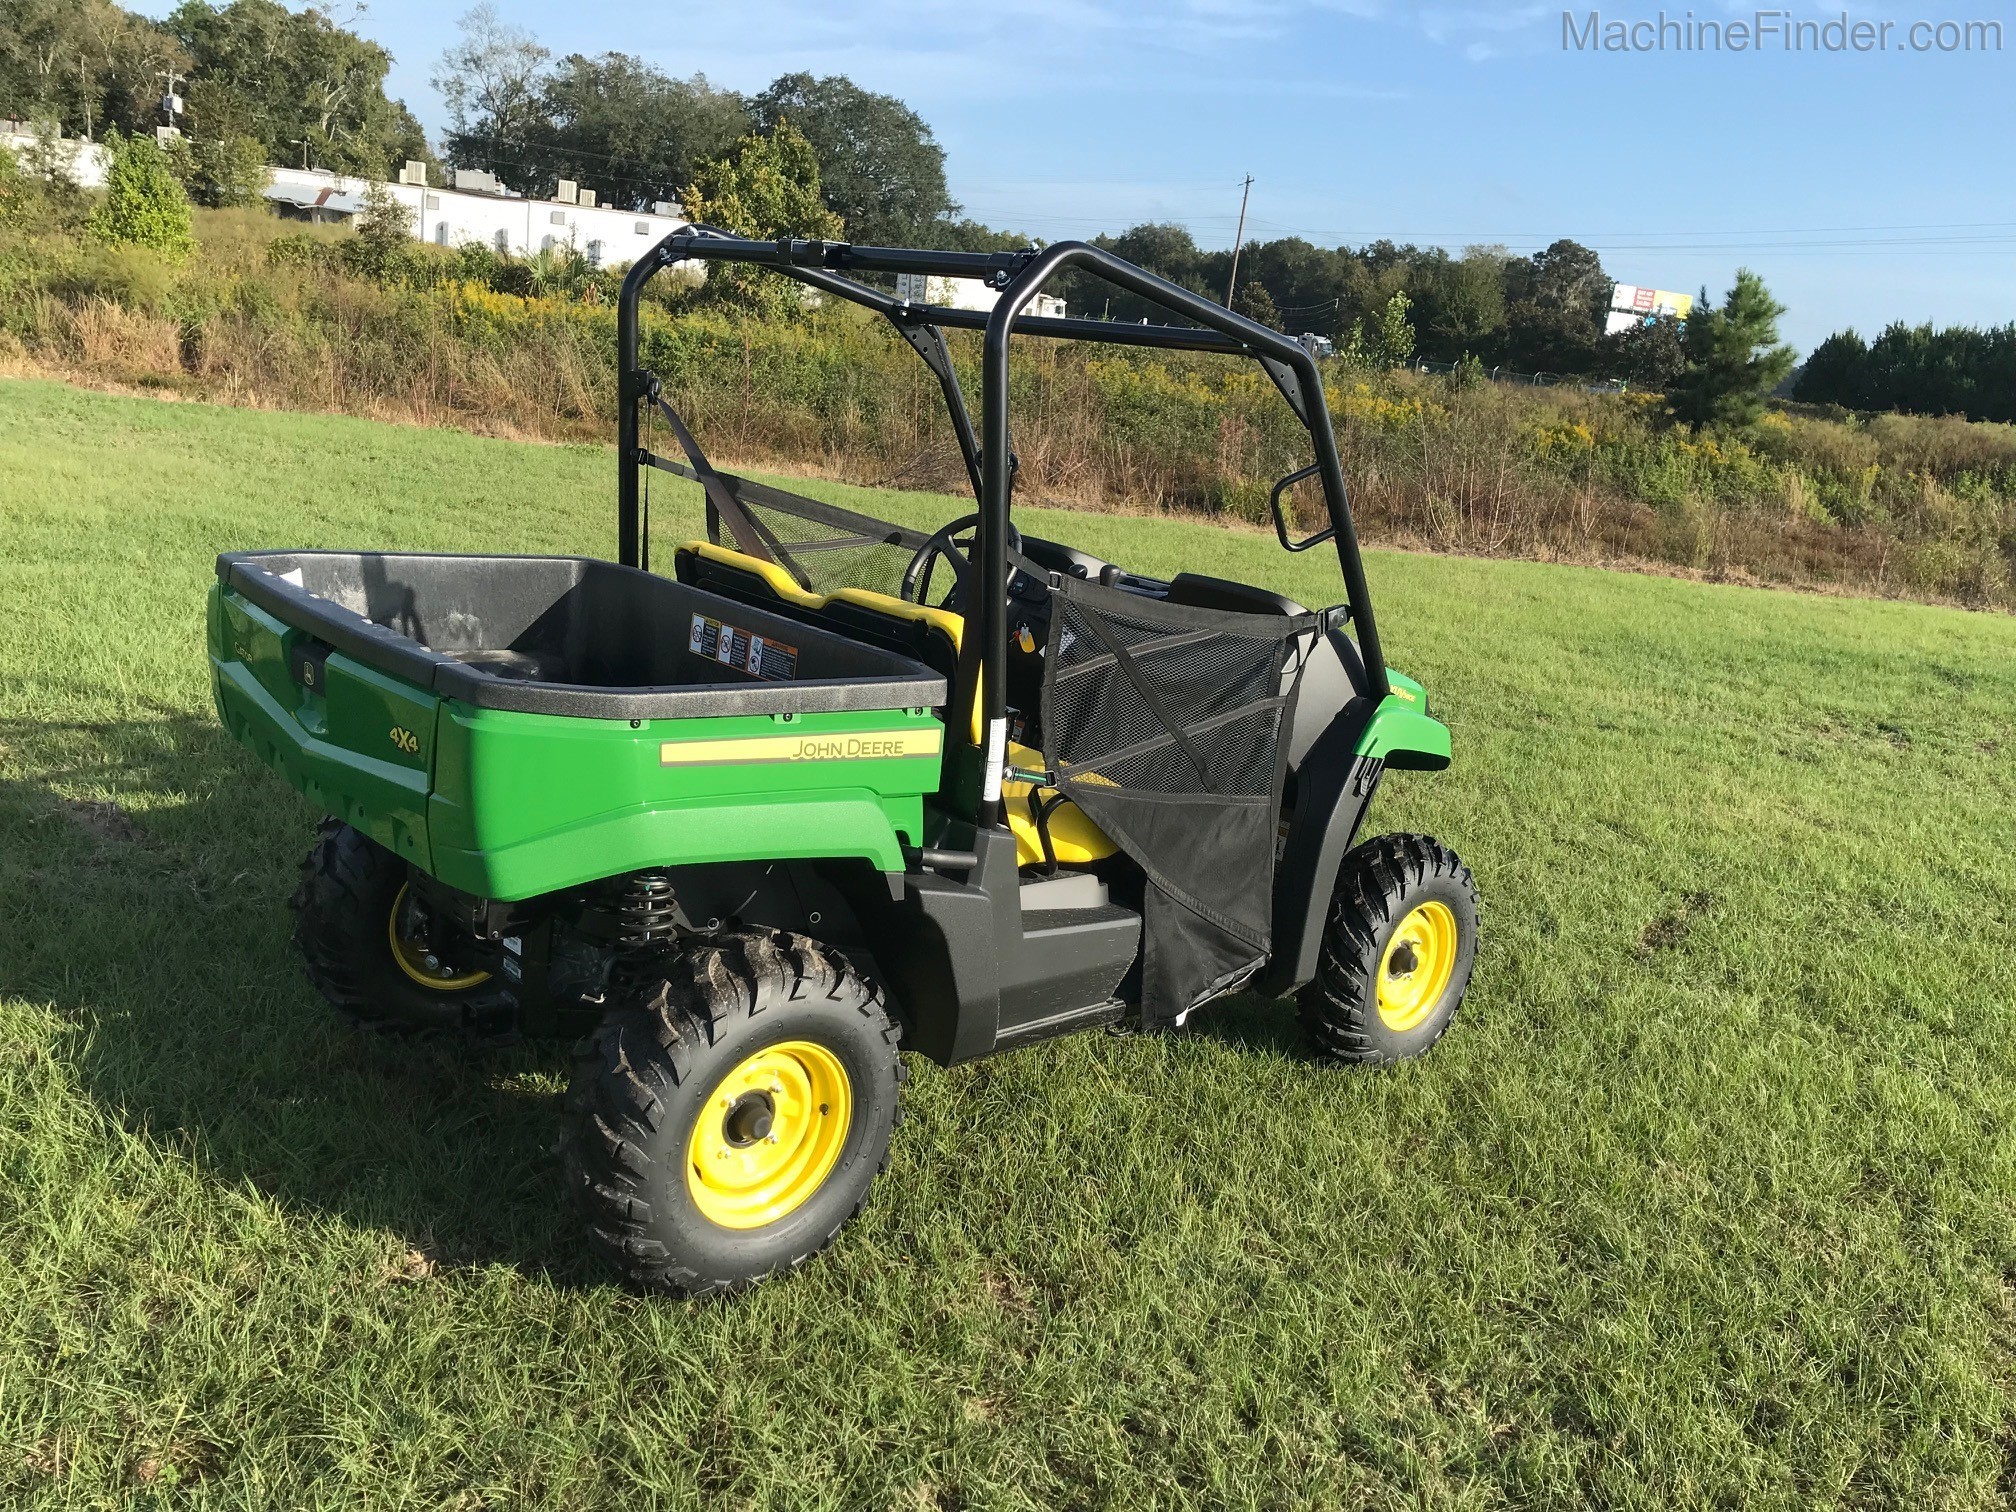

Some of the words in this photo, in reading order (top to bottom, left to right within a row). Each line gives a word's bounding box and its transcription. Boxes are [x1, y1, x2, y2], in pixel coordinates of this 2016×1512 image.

[389, 726, 419, 752] 4X4
[792, 740, 842, 758] JOHN
[847, 738, 904, 756] DEERE
